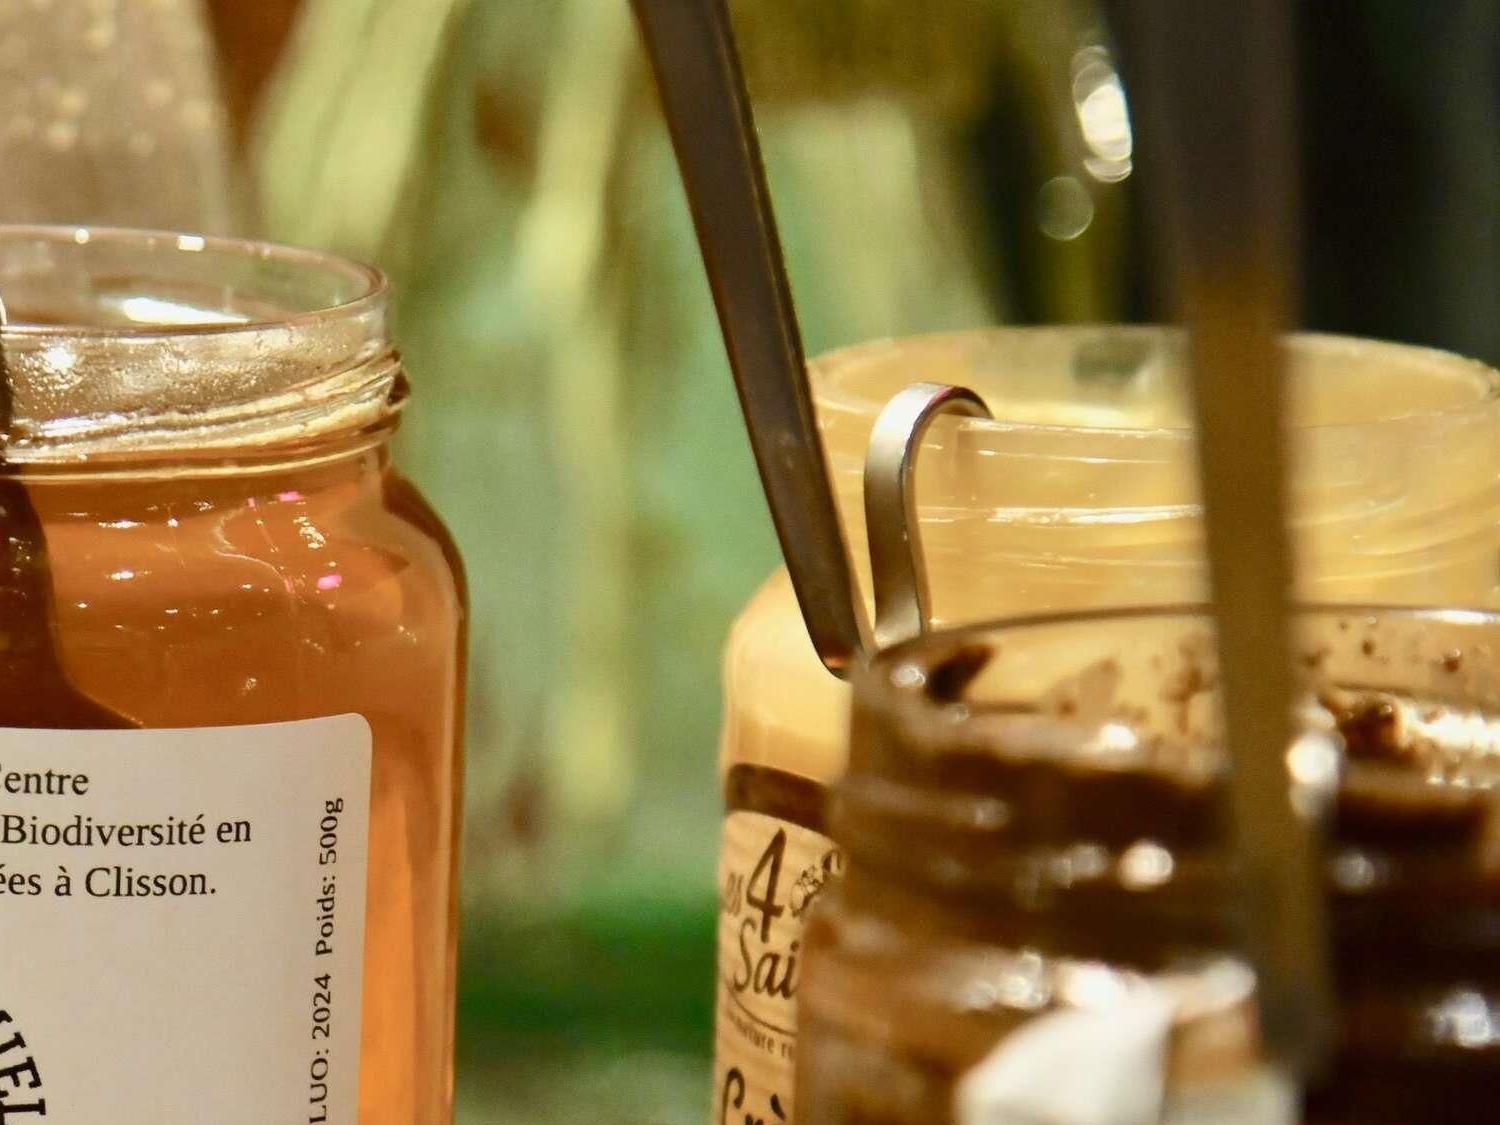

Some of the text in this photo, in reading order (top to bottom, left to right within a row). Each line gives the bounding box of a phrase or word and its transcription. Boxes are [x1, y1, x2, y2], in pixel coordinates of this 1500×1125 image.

[0, 813, 206, 847] Biodiversité
[216, 818, 252, 844] en
[319, 797, 344, 866] 500g
[54, 866, 71, 896] à
[85, 866, 216, 898] Clisson.
[315, 875, 336, 956] Poids:
[746, 827, 787, 944] 4
[312, 973, 332, 1040] 2024
